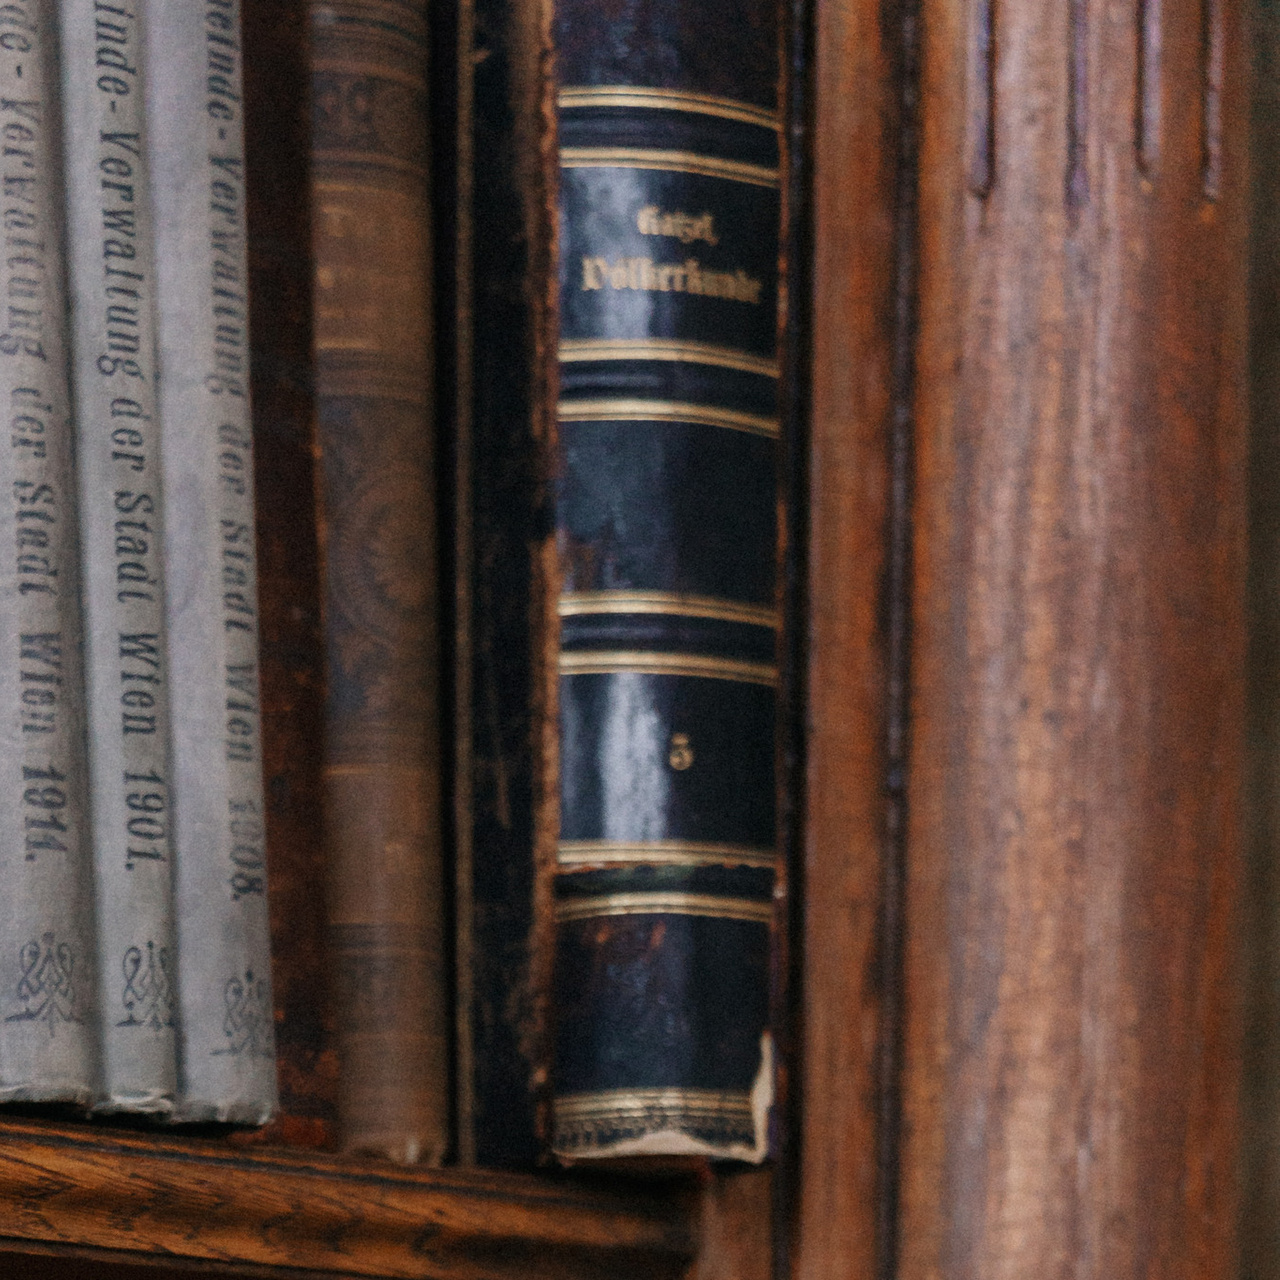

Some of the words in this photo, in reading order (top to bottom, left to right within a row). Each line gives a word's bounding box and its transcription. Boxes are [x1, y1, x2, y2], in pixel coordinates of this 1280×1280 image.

[96, 128, 147, 382] Verwaltung
[203, 153, 246, 398] Verwaltung
[10, 386, 53, 459] der
[110, 397, 152, 472] der
[218, 423, 252, 496] der
[13, 480, 59, 597] Stadt
[113, 490, 159, 605] Stadt
[220, 518, 256, 632] Stadt
[19, 631, 63, 735] Wien
[119, 632, 162, 737] Wien
[224, 661, 257, 765] Wien
[124, 768, 168, 873] 1901.
